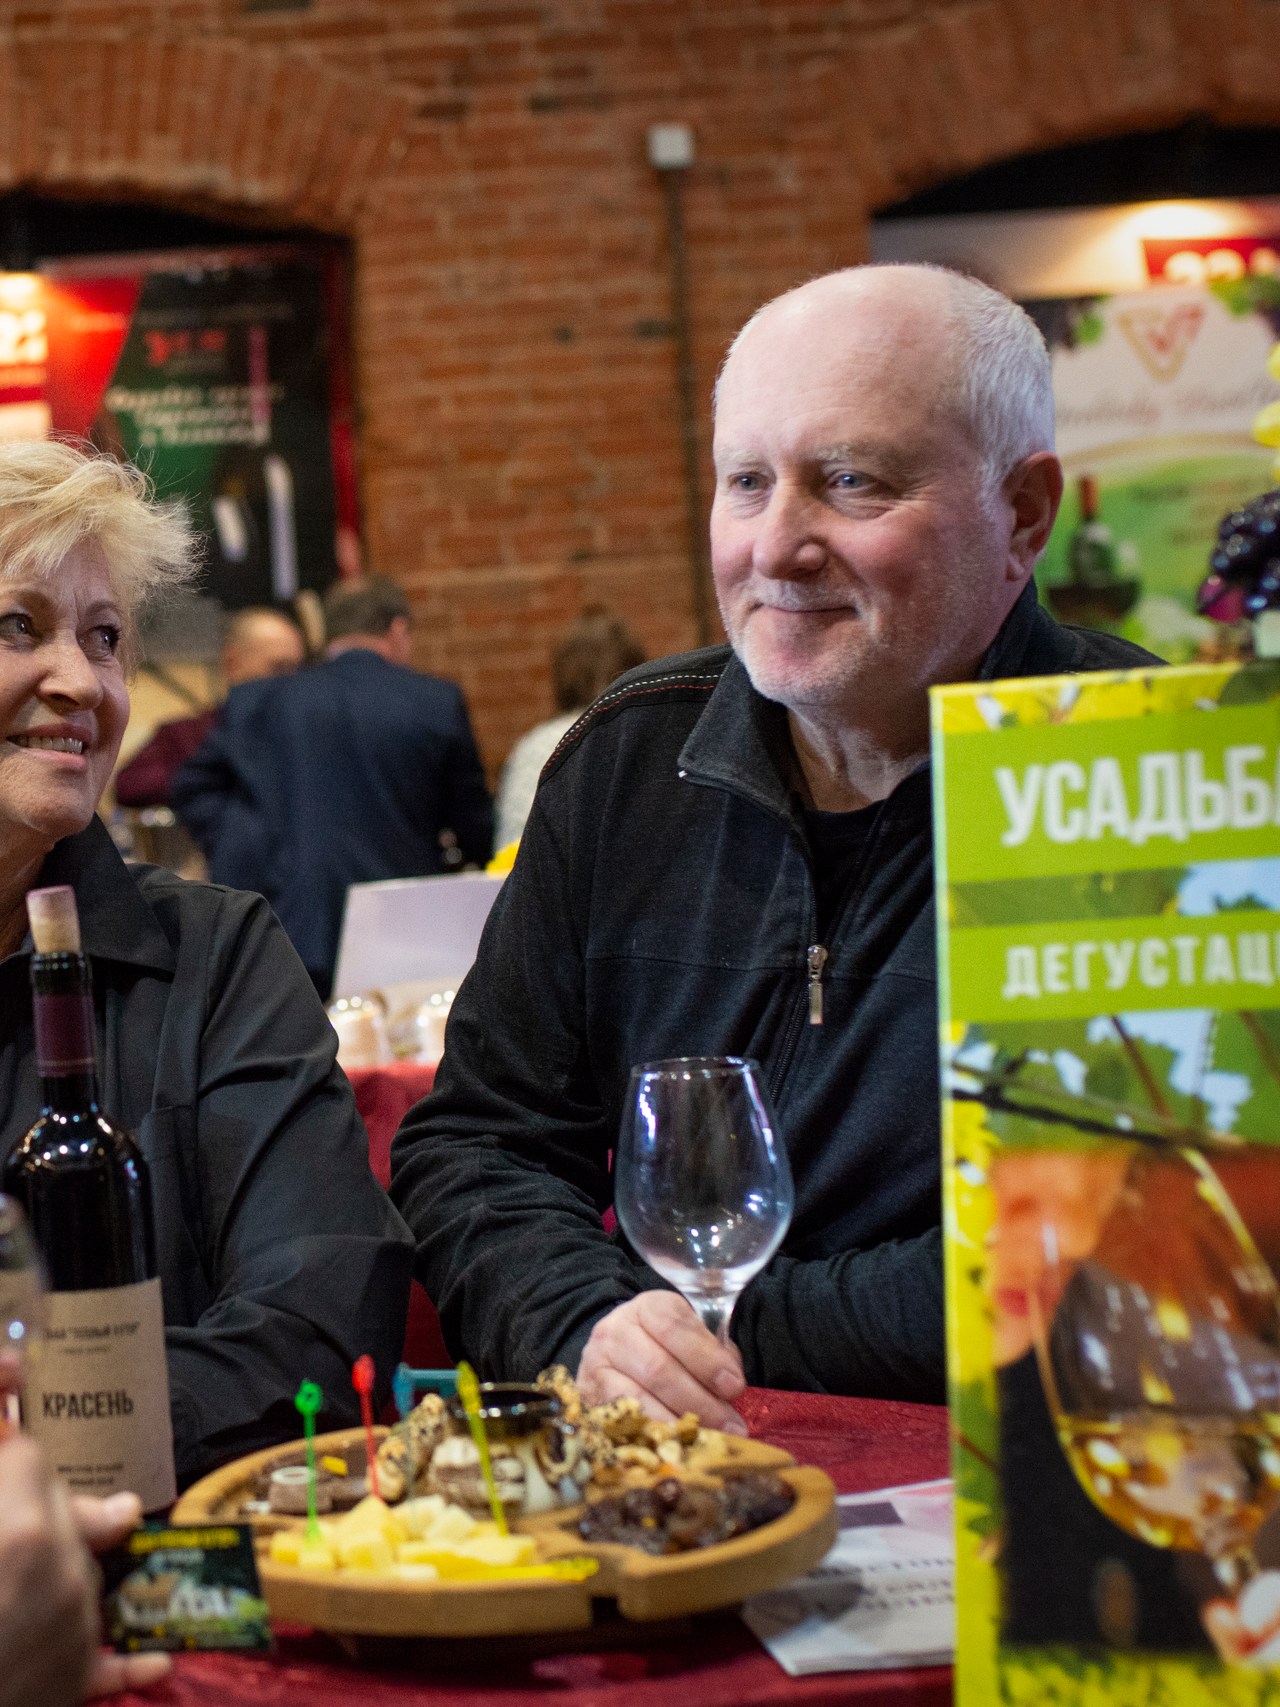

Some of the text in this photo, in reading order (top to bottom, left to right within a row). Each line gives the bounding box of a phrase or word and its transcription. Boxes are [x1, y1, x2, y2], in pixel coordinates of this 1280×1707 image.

[995, 745, 1280, 846] УСАДЬБ
[1002, 932, 1280, 1001] ДЕГУСТАЦ
[43, 1390, 134, 1419] КРАСЕНЬ
